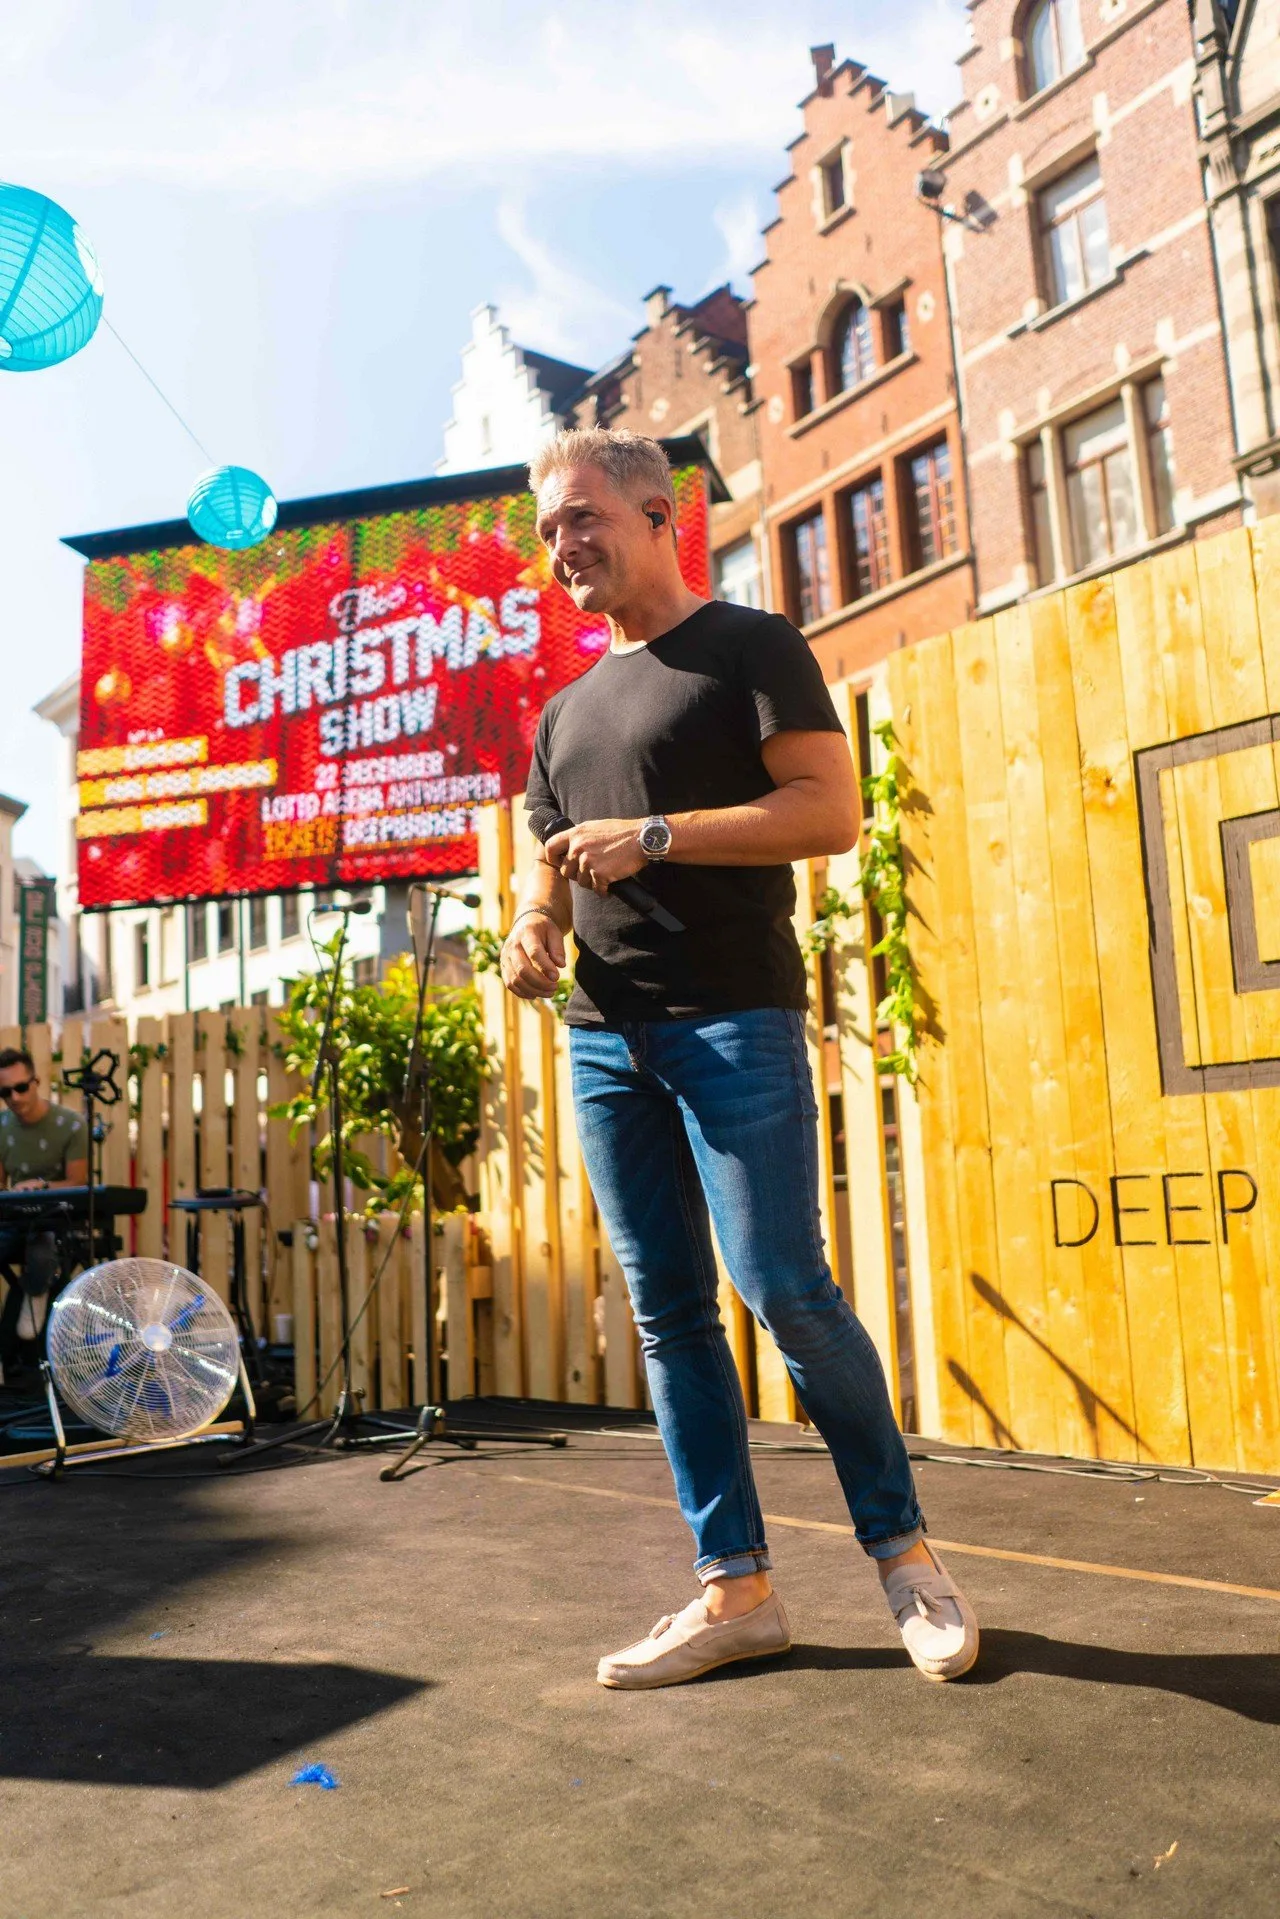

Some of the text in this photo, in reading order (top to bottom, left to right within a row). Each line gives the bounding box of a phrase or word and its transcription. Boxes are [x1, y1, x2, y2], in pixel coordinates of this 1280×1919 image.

[224, 587, 541, 728] CHRISTMAS
[319, 683, 438, 756] SHOW
[261, 772, 500, 822] LOTTO ARENA ANTWERPEN
[342, 750, 444, 787] DECEMBER
[1051, 1169, 1258, 1247] DEEP
